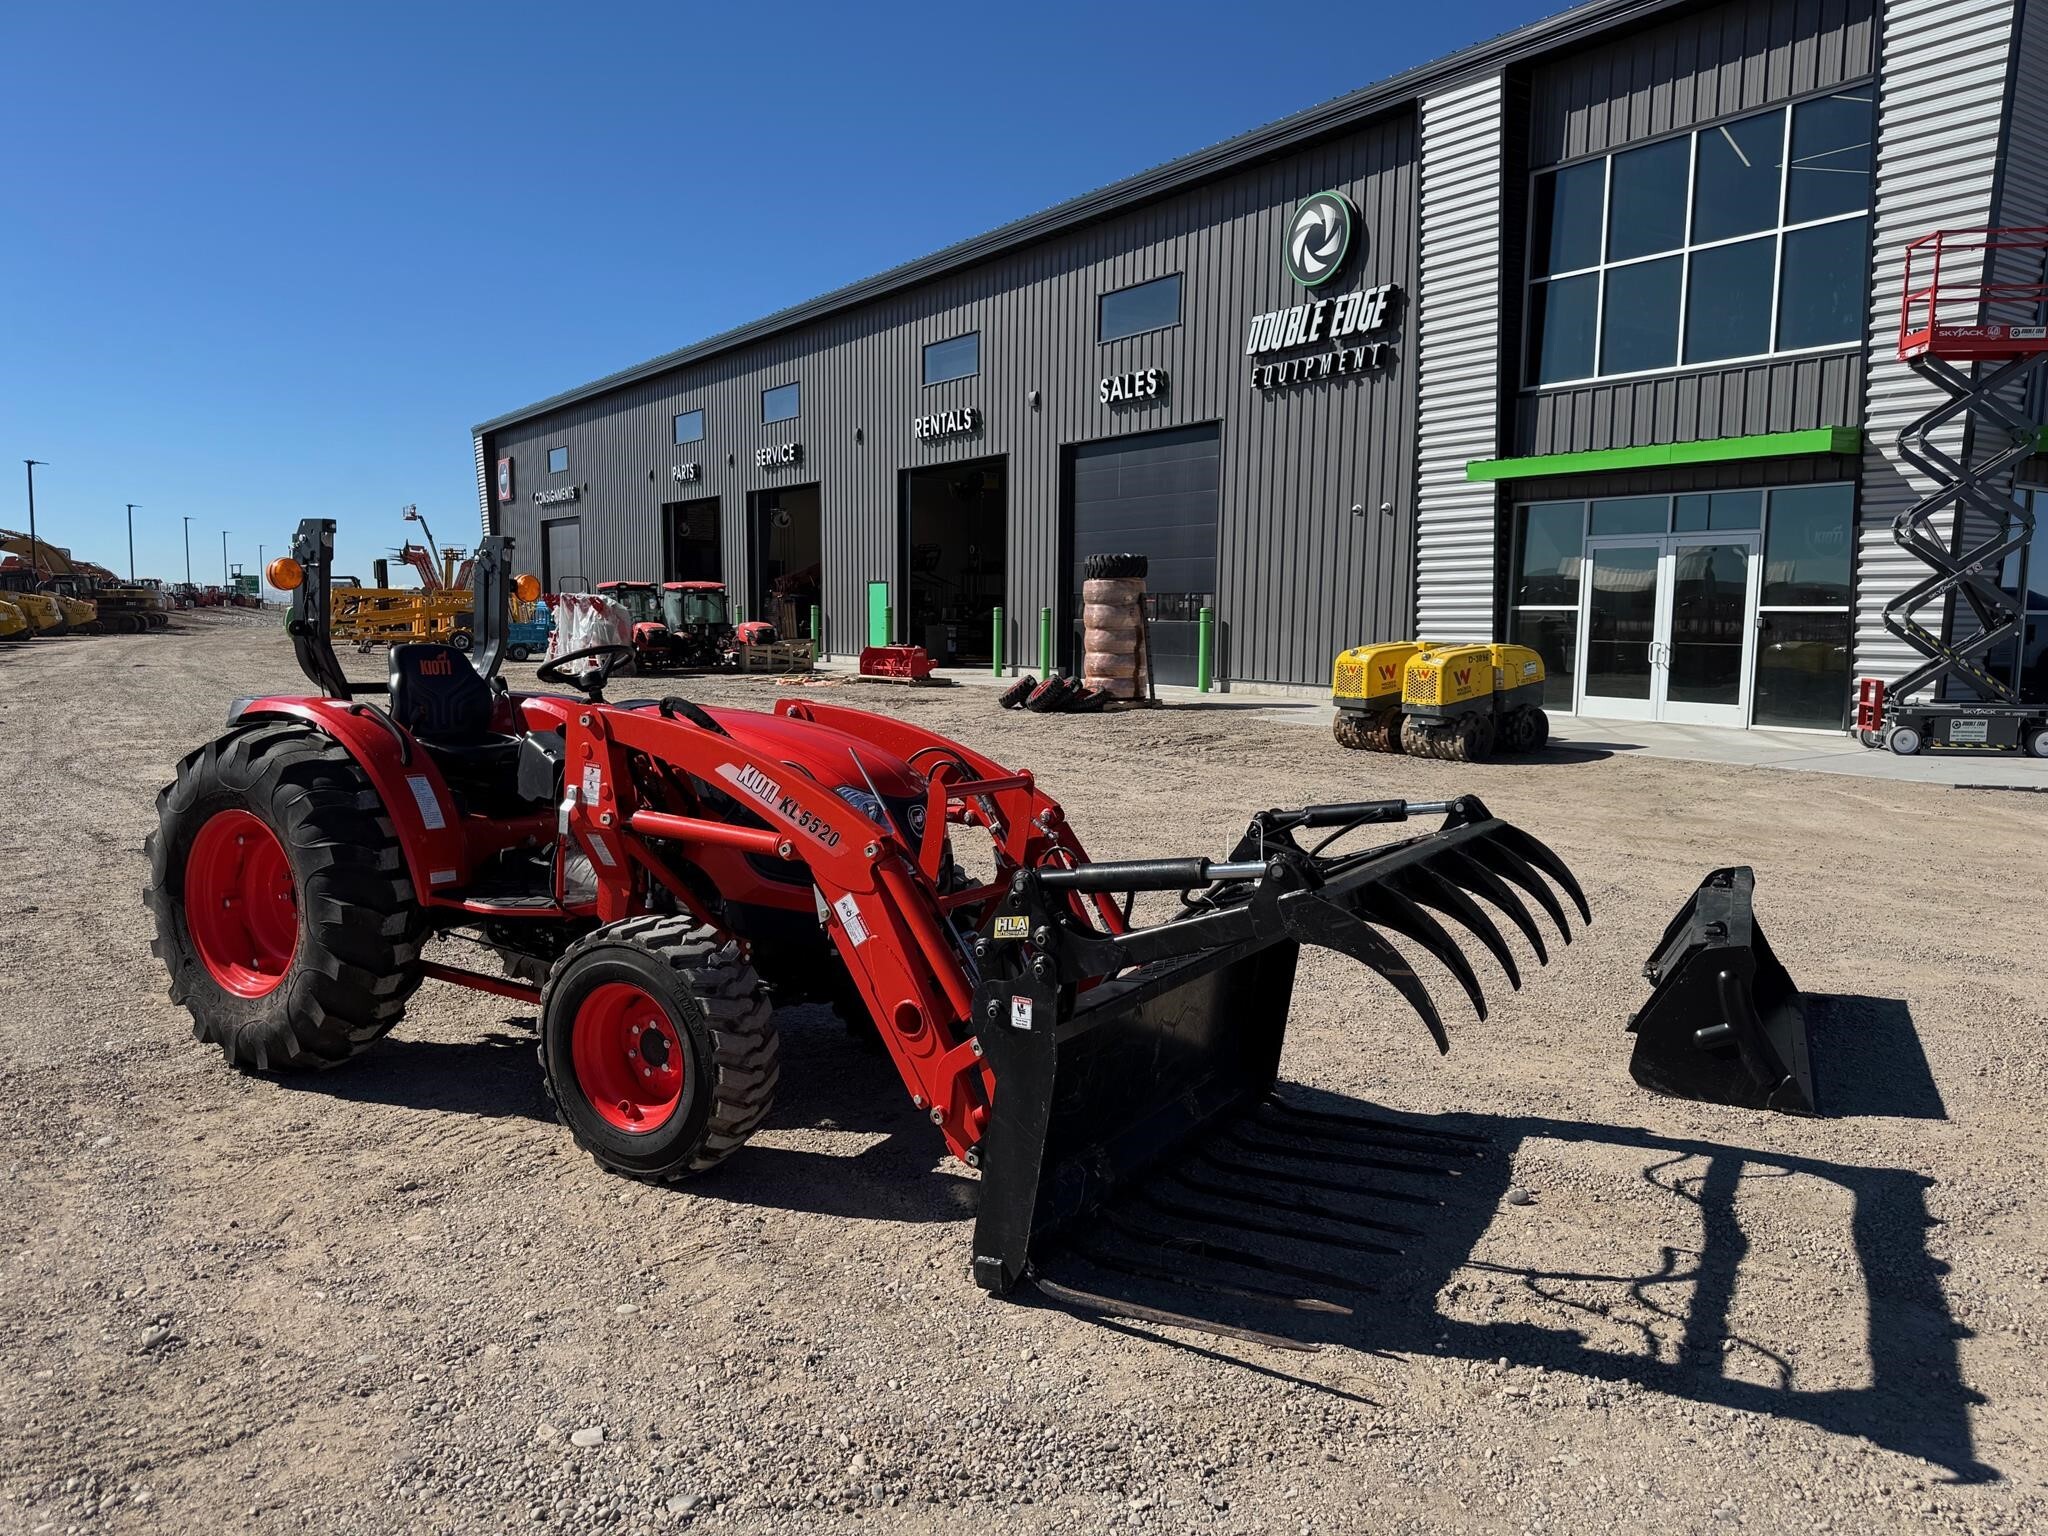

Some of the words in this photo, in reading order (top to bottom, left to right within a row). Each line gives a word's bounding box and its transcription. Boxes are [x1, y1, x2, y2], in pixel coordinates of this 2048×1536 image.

[1246, 300, 1327, 355] DOUBLE
[1329, 284, 1392, 338] EDGE
[1939, 327, 1984, 338] SKYJACK
[1250, 343, 1381, 388] EQUIPMENT
[1100, 368, 1157, 403] SALES
[914, 408, 972, 439] RENTALS
[756, 443, 795, 467] SERVICE
[673, 463, 695, 480] PARTS
[534, 486, 575, 505] CONSIGNMENTS
[419, 654, 452, 675] KIOTI
[736, 762, 782, 804] KIOTI
[996, 917, 1028, 931] HLA
